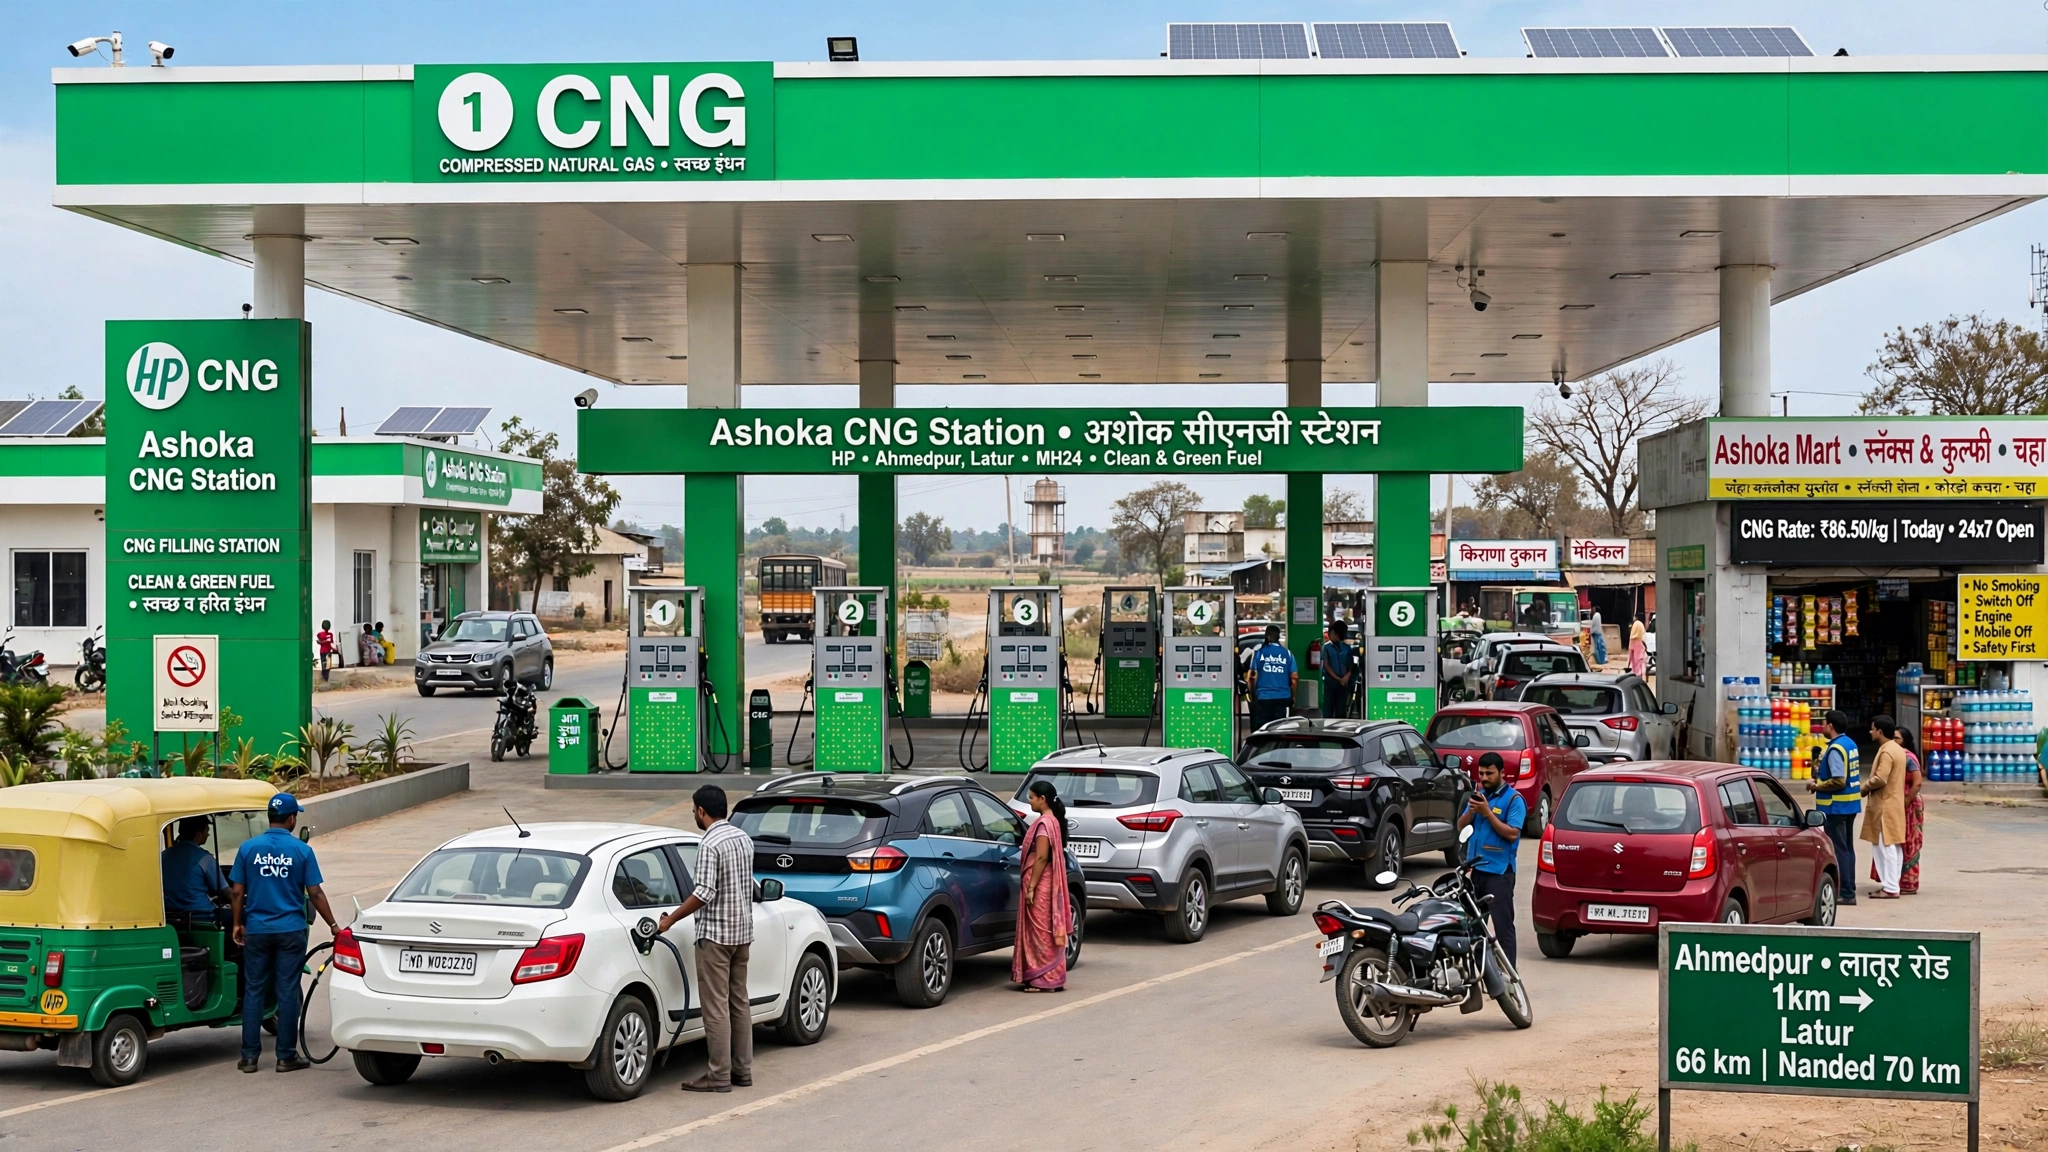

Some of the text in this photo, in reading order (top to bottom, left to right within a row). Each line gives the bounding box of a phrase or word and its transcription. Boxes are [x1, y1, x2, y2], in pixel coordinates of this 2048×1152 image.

[463, 73, 745, 148] 1 CNG
[440, 153, 745, 173] COMPRESSED NATURAL GAS स्वच्छ इंधन
[134, 346, 277, 400] HP CNG
[710, 411, 1381, 448] Ashoka CNG Station अशोक सीएनजी स्टेशन
[139, 430, 253, 457] Ashoka
[1715, 435, 1789, 464] Ashoka
[1797, 435, 1840, 464] Mart
[1920, 435, 1933, 463] &
[1941, 428, 1991, 474] कुल्फी
[2013, 438, 2046, 466] चहा
[832, 450, 1261, 469] HP Ahmedpur, Latur MH24 Clean & Green Fuel
[130, 468, 275, 490] CNG Station
[1741, 519, 2034, 543] CNG Rate: ₹86.50/kg Today 24x7 Open
[124, 538, 279, 553] CNG FILLING STATION
[1573, 543, 1625, 559] मेडिकल
[1460, 544, 1546, 567] किराणा दुकान
[129, 575, 274, 589] CLEAN & GREEN FUEL
[1974, 579, 2039, 593] No Smoking
[142, 592, 266, 614] स्वच्छ व हरित इंधन
[1977, 594, 2033, 606] Switch Off
[659, 604, 668, 621] 1
[845, 604, 857, 621] 2
[1020, 604, 1032, 621] 3
[1193, 604, 1206, 621] 4
[1396, 606, 1409, 622] 5
[1976, 610, 2012, 625] Engine
[1975, 626, 2032, 637] Mobile Off
[1974, 641, 2035, 655] Safety First
[253, 852, 293, 866] Ashoka
[259, 864, 289, 879] CNG
[1675, 944, 1951, 990] Ahmedpur लातूर रोड
[1773, 983, 1829, 1011] 1km
[1782, 1017, 1854, 1046] Latur
[1676, 1047, 1960, 1084] 66 km Nanded 70 km
